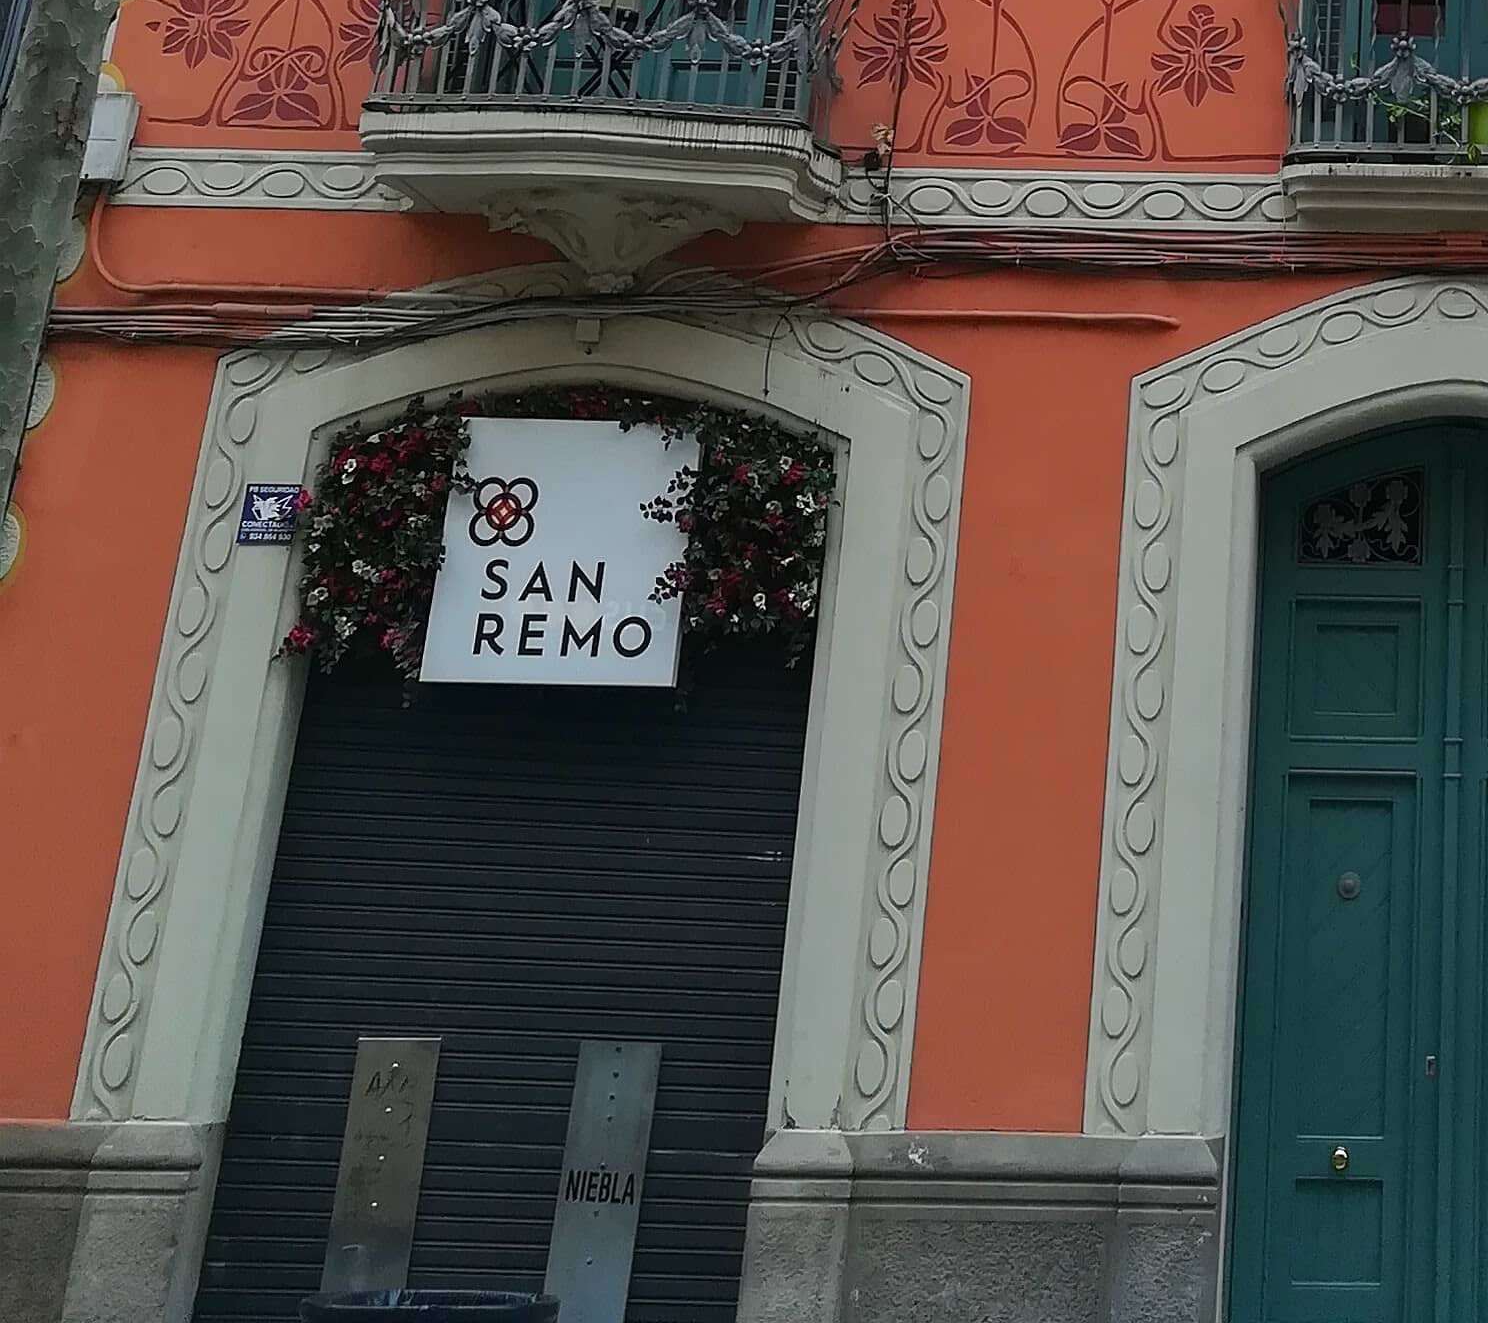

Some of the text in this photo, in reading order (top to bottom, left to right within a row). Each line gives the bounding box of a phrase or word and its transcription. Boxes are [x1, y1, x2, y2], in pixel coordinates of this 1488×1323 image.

[480, 558, 606, 604] SAN
[472, 612, 652, 658] REMO
[564, 1169, 635, 1205] NIEBLA
